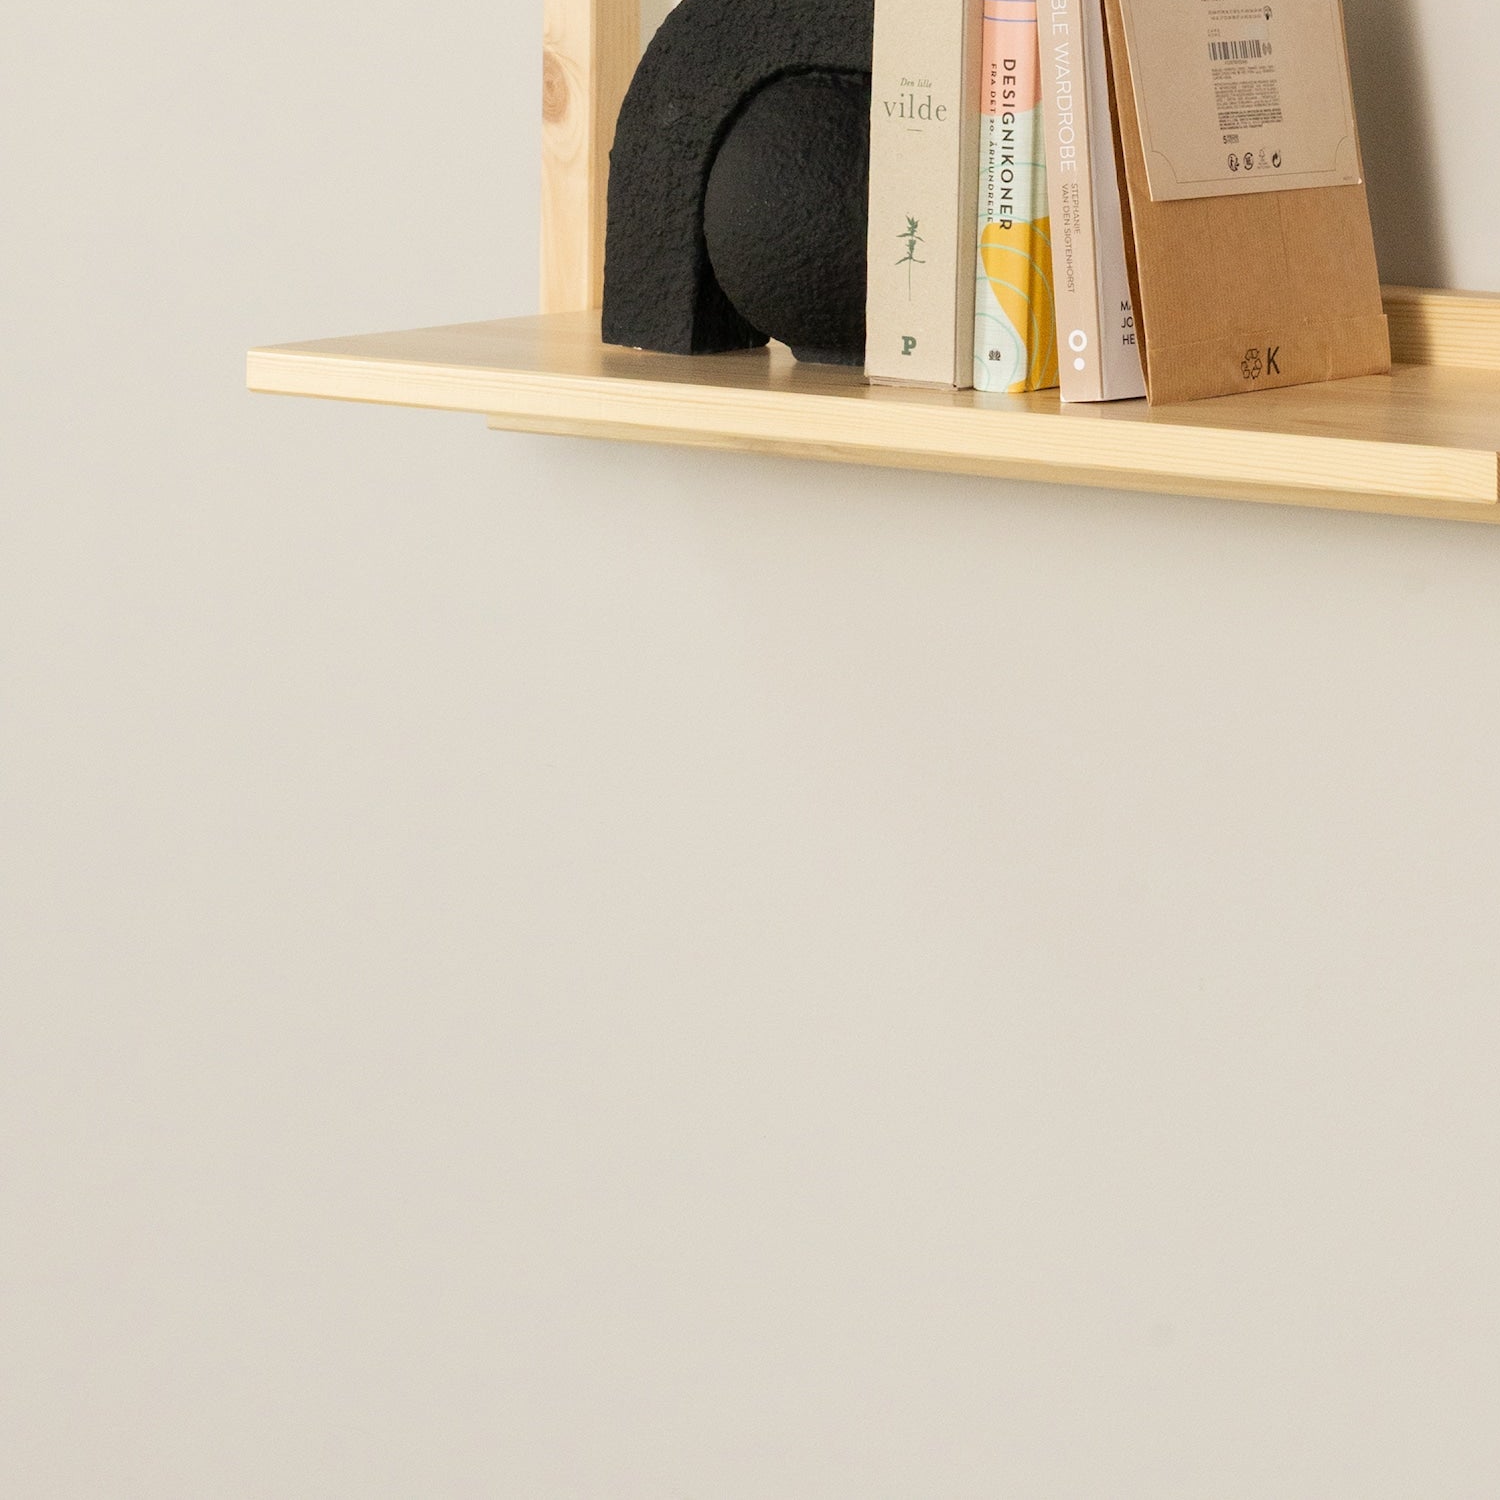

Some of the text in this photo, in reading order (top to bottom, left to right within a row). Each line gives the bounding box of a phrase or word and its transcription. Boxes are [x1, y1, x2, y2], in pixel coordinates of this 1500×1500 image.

[900, 77, 932, 88] Den lille
[883, 93, 947, 122] vilde
[989, 92, 997, 114] DET
[1053, 42, 1077, 173] WARDROBE
[999, 58, 1016, 230] DESIGNIKONER
[987, 141, 998, 223] ÅRHUNDREDE
[1071, 183, 1081, 234] STEPHANIE
[1064, 228, 1075, 294] SIGTENHORST
[901, 336, 917, 356] P
[1267, 346, 1280, 375] K
